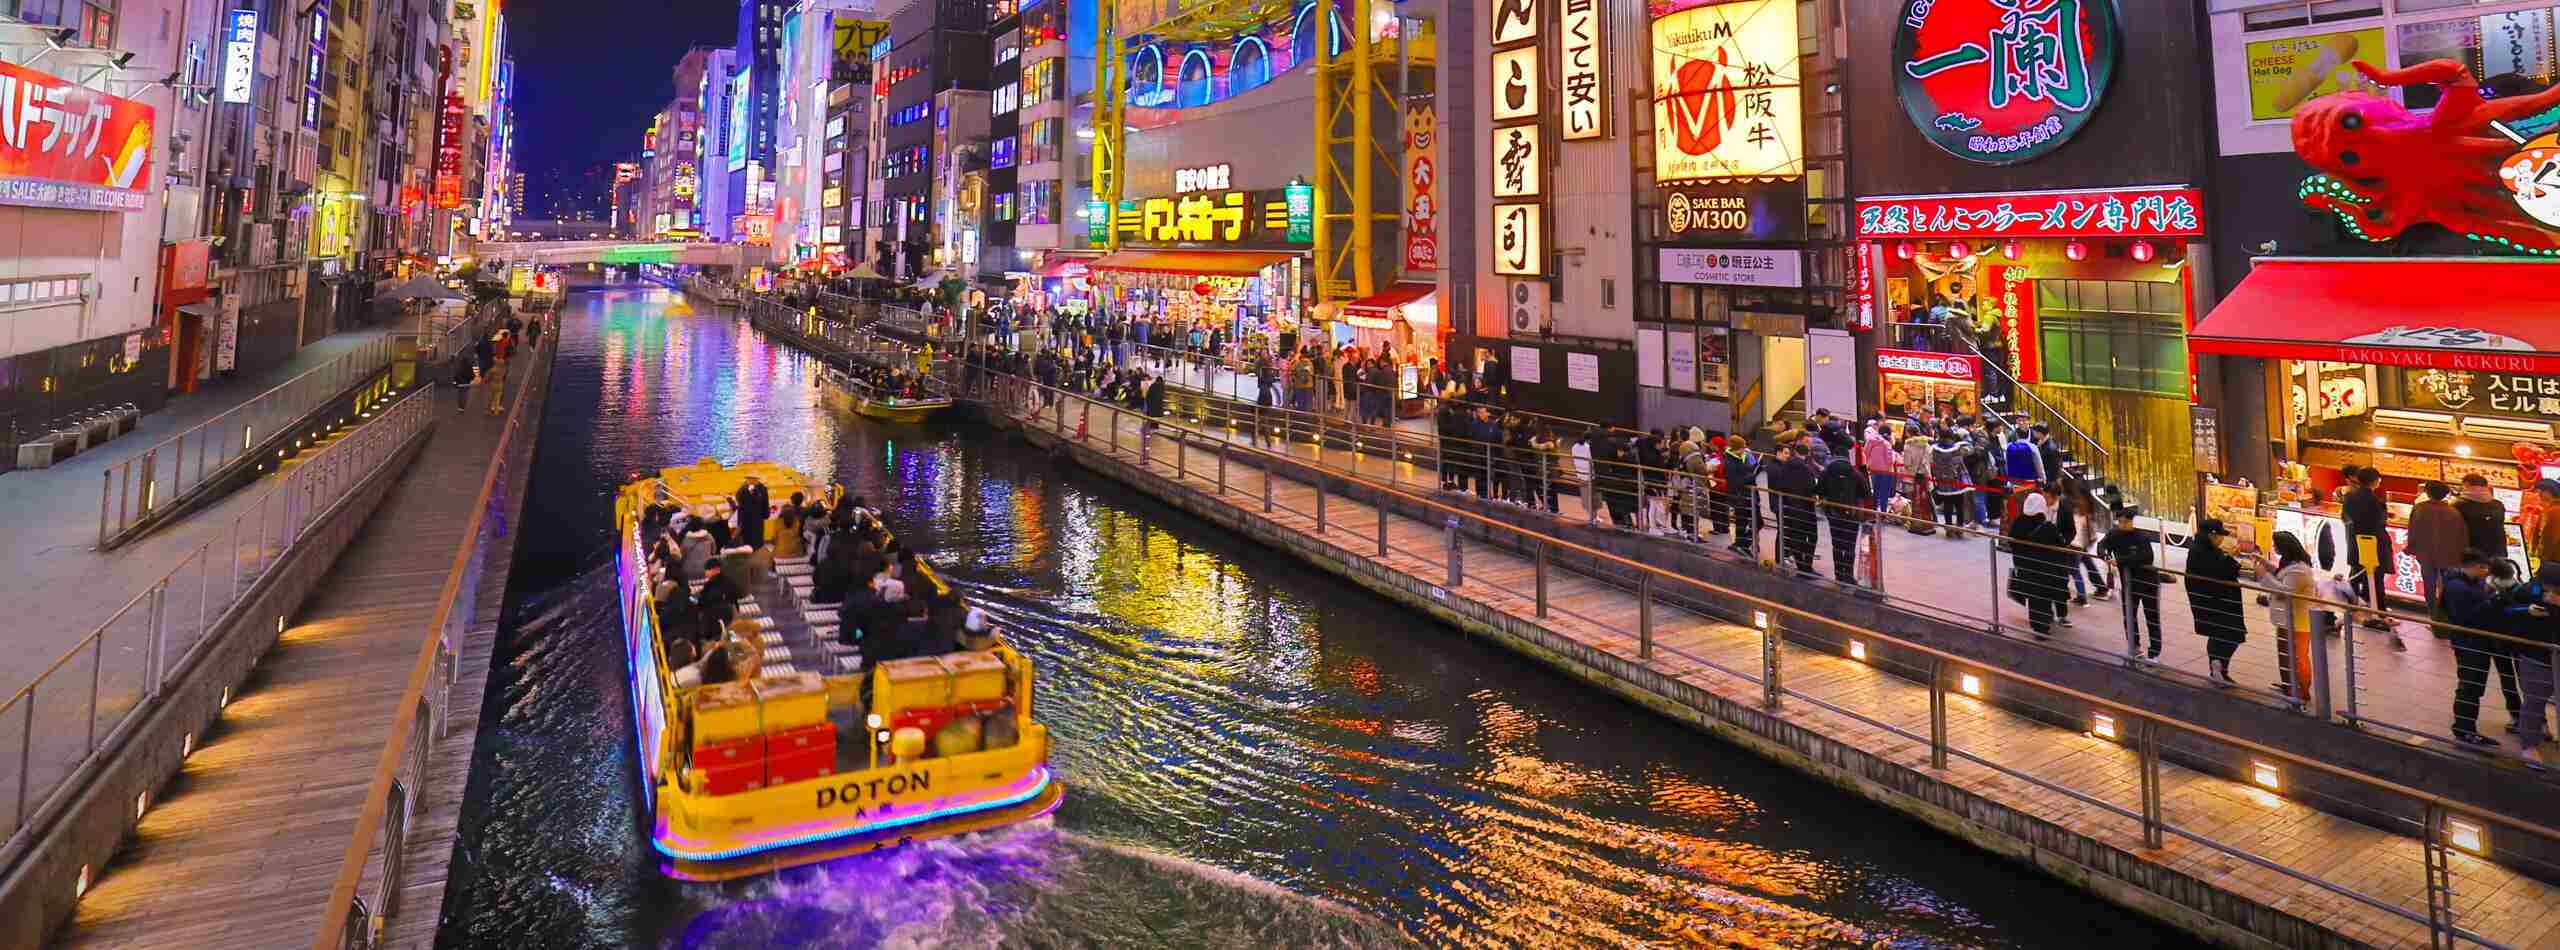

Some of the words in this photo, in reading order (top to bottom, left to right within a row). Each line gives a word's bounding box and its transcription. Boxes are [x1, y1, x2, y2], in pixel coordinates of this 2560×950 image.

[1906, 0, 2091, 111] 一蘭
[1744, 62, 1776, 150] 松阪牛
[1692, 199, 1718, 209] SAKE
[1720, 198, 1746, 209] BAR
[1860, 196, 2198, 234] 天然とんこつラーメン専門店
[1692, 211, 1746, 229] M300
[2453, 355, 2535, 371] KUKURU
[2487, 374, 2560, 395] 入口は
[817, 770, 929, 809] DOTON
